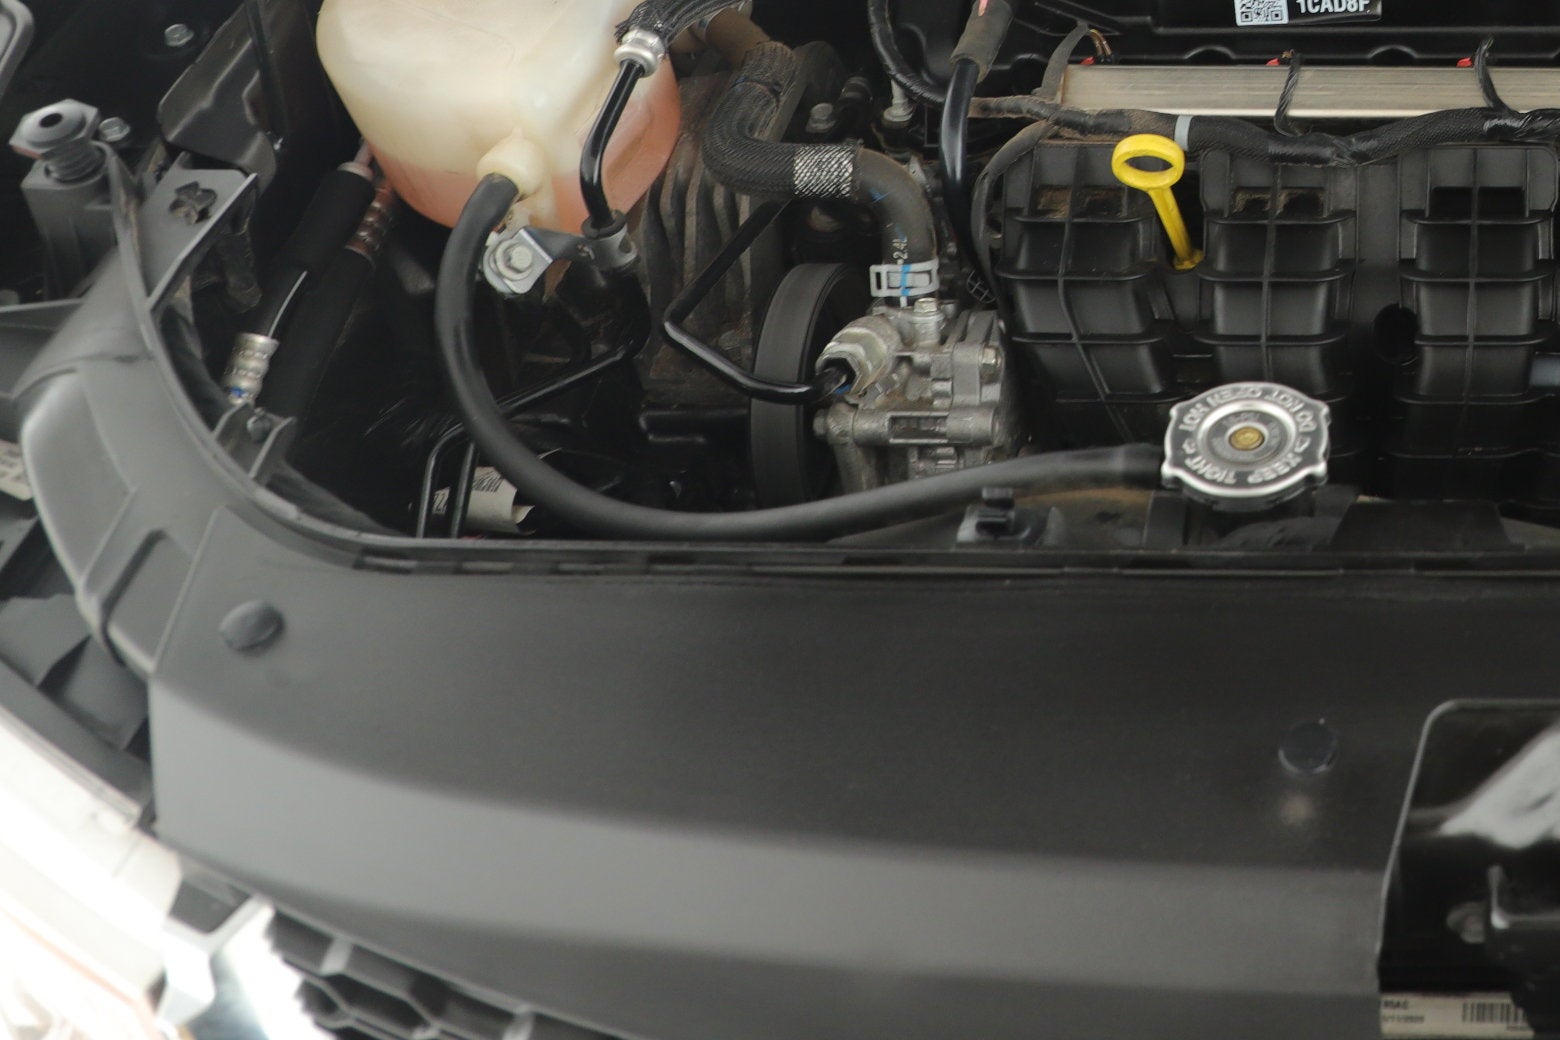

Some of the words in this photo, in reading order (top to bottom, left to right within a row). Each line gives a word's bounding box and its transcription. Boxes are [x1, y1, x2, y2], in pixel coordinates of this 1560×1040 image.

[1206, 387, 1263, 407] OPEN
[1264, 391, 1305, 413] NOT
[1294, 410, 1318, 432] DO
[1184, 455, 1238, 485] TIGHT
[1246, 453, 1303, 484] KEEP
